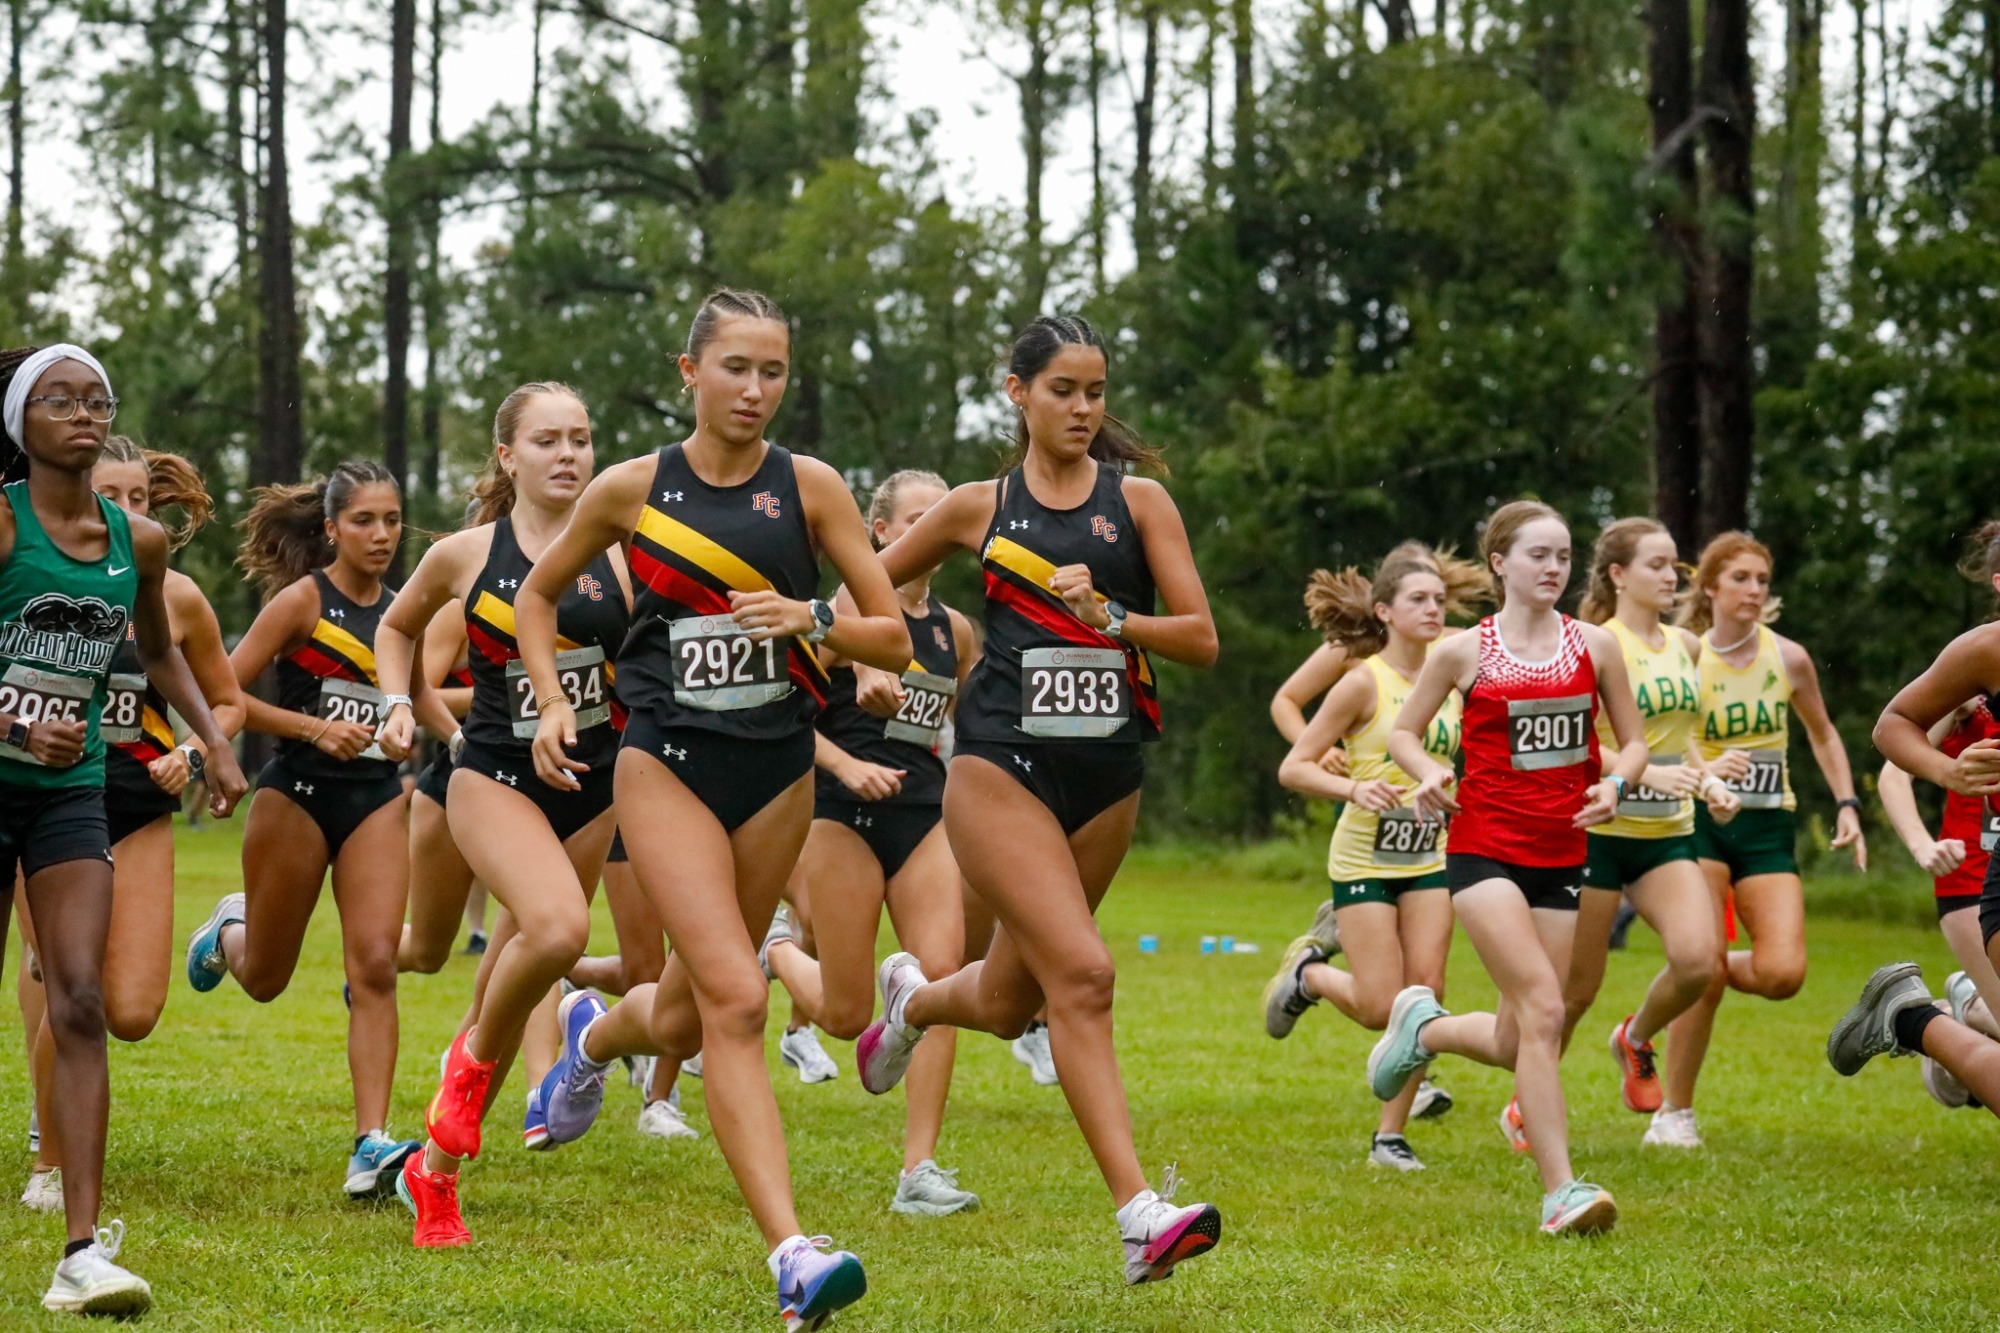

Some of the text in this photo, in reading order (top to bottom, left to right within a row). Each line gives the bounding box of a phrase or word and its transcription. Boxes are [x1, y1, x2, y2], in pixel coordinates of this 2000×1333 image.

[753, 491, 781, 518] FC
[1091, 515, 1118, 542] FC
[577, 574, 603, 601] FC
[681, 636, 775, 688] 2921
[517, 666, 603, 718] 234
[896, 687, 948, 729] 2923
[1031, 670, 1119, 714] 2933
[1636, 676, 1700, 718] ABA
[1516, 712, 1584, 752] 2901
[1380, 820, 1438, 853] 2875
